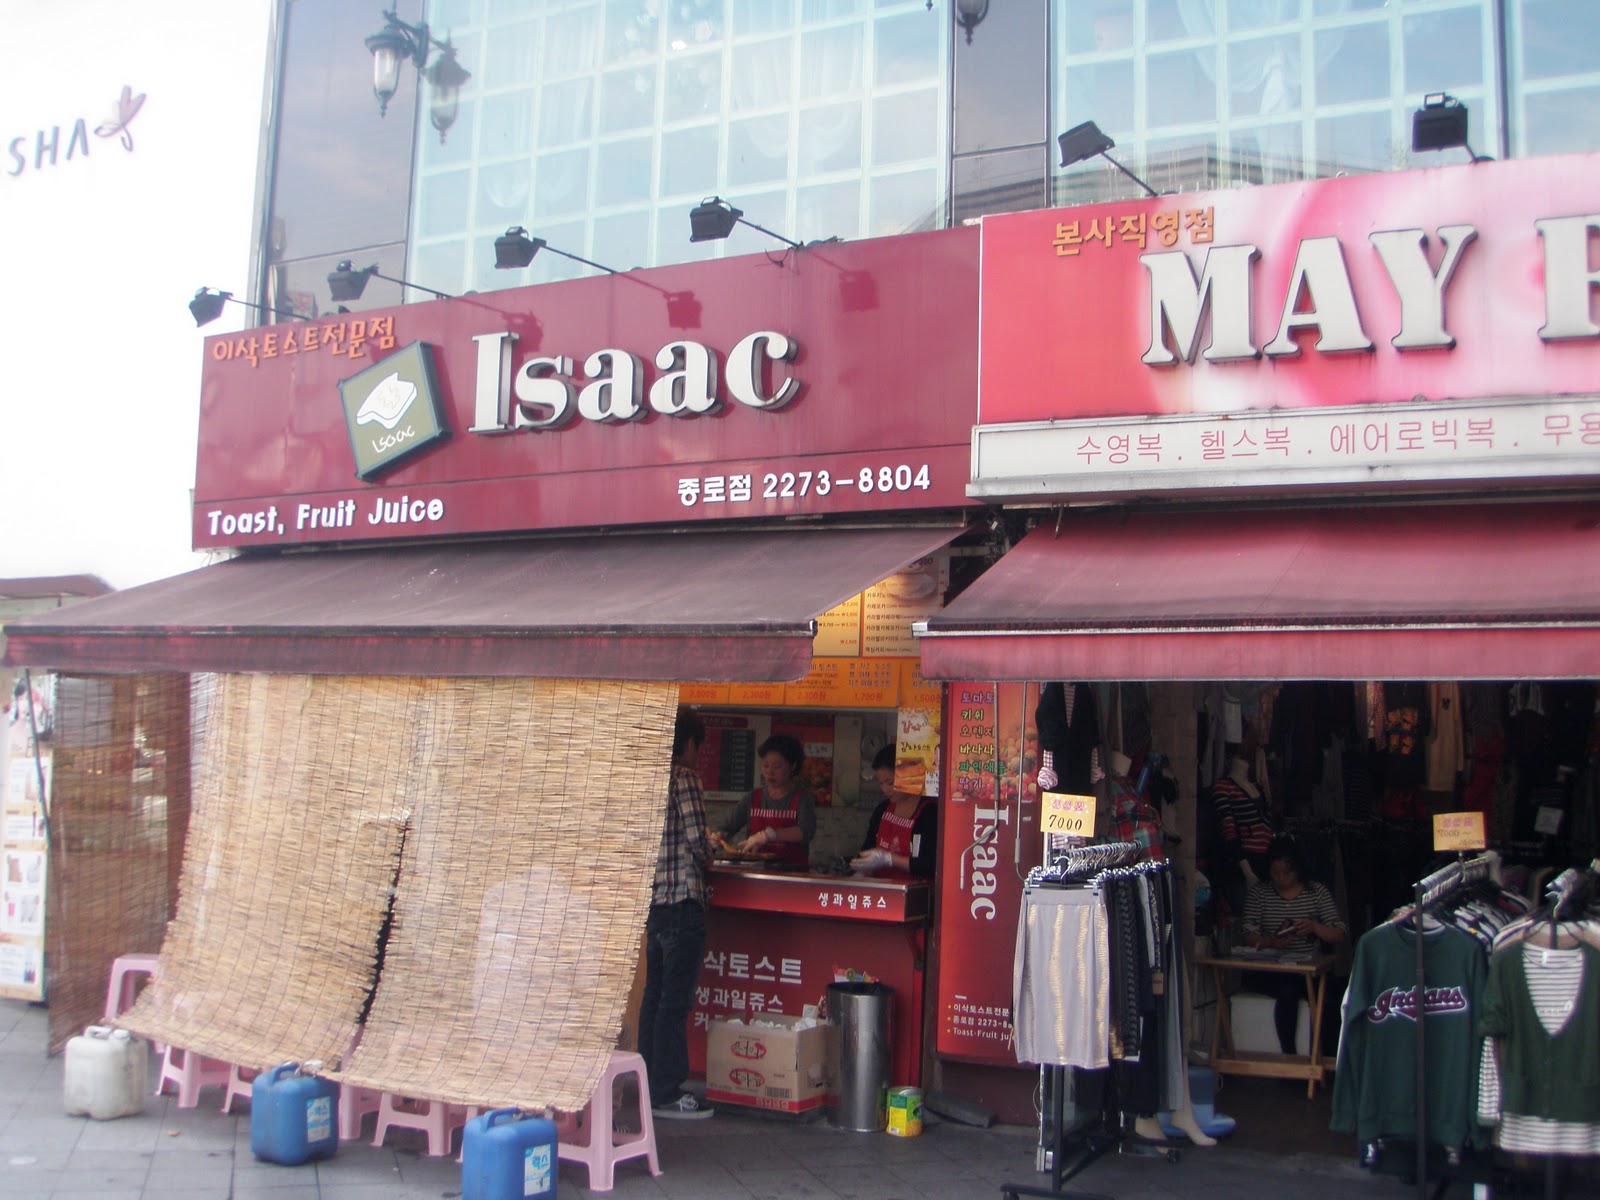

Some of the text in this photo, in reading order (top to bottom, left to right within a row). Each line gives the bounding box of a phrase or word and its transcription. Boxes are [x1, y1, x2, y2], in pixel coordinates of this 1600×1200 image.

[1052, 206, 1216, 257] 본사직영점
[1138, 224, 1478, 367] MAY
[212, 316, 396, 368] 이삭토스트전문점
[468, 330, 800, 434] Isaac
[1076, 412, 1600, 465] 수영복 헬스복 에어로빅복 무용
[677, 464, 930, 507] 종로점 2273-8804
[208, 496, 444, 536] Toast, Fruit Juice
[962, 692, 996, 704] 토마토
[961, 709, 984, 721] 키위
[961, 725, 996, 738] 오렌지
[959, 743, 996, 755] 바나나
[959, 761, 1007, 774] 파인애플
[959, 777, 983, 790] 딸기
[1049, 814, 1083, 831] 7000
[970, 804, 1009, 920] Isaac
[818, 892, 887, 909] 생과일쥬스
[703, 950, 802, 984] 삭토스트
[695, 986, 783, 1013] 생과일쥬스
